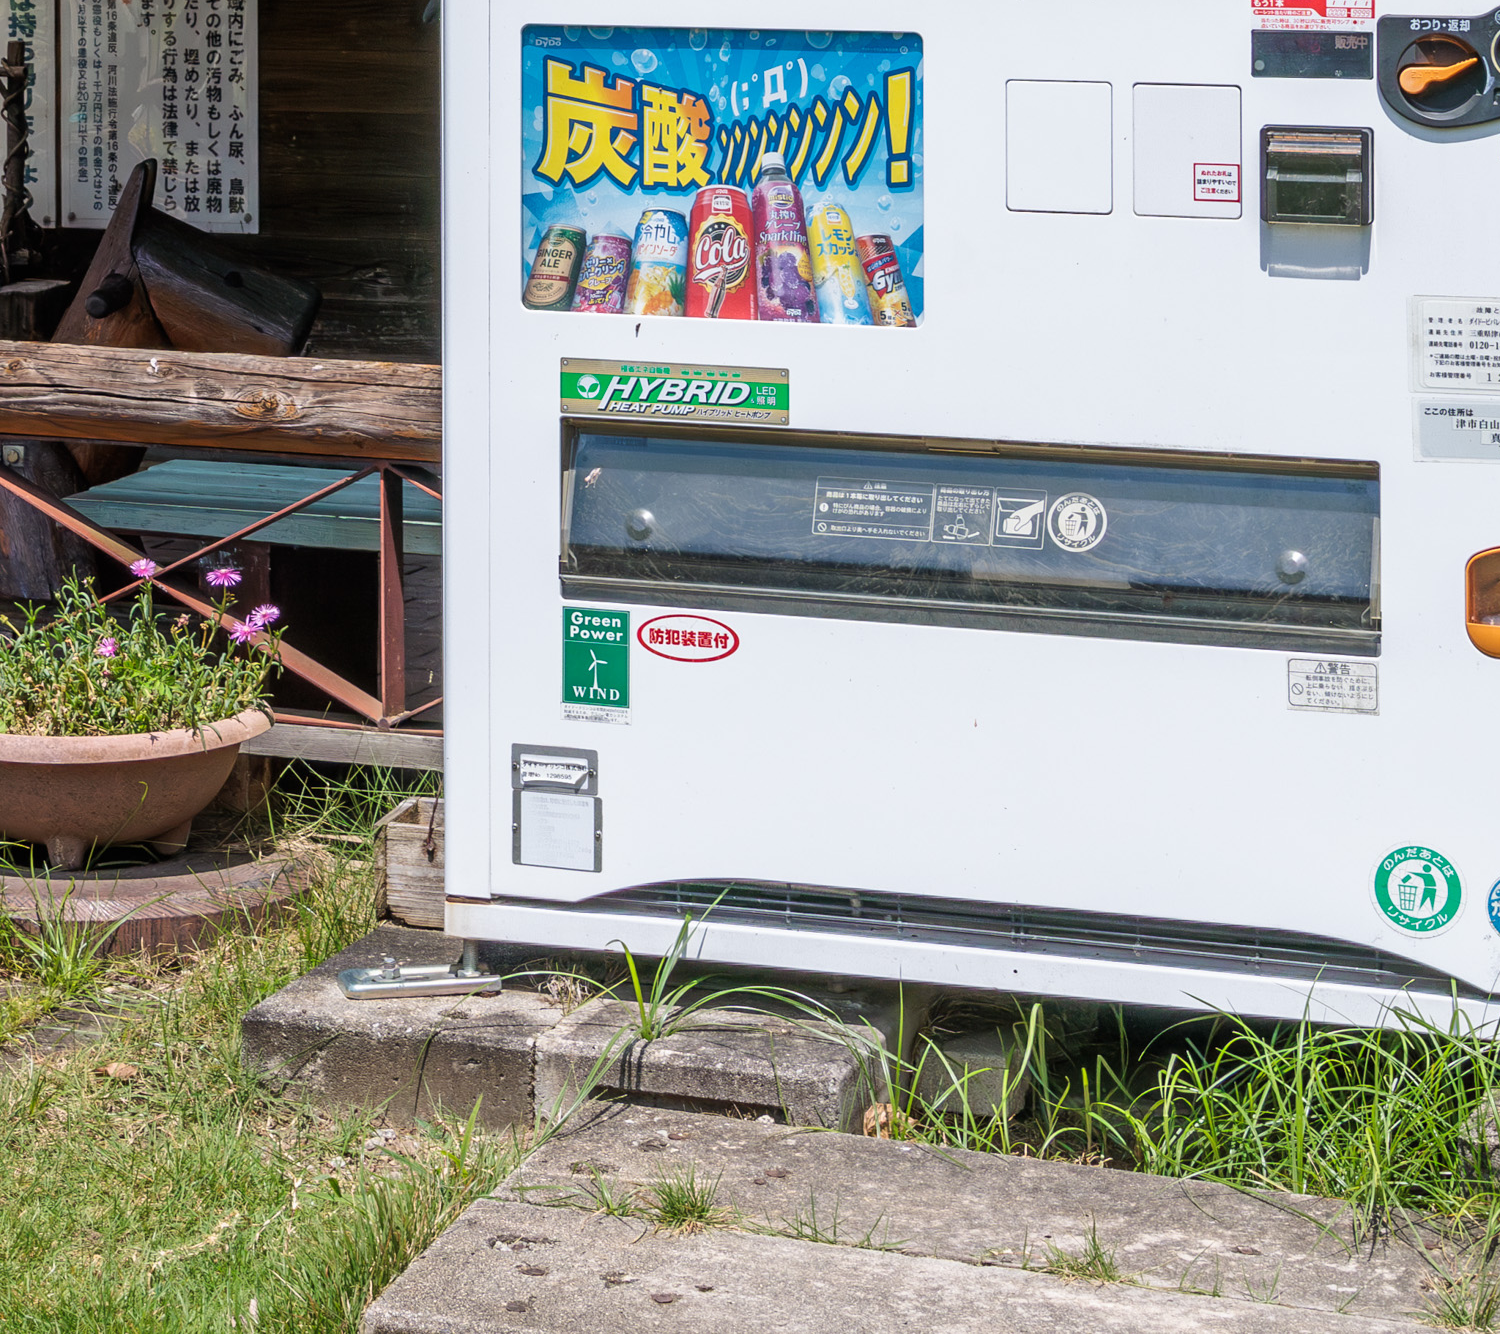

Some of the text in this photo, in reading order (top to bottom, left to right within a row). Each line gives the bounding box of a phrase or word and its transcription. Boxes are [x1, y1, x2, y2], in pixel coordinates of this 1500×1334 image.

[1253, 0, 1285, 7] もう1本
[535, 36, 562, 47] DyDo
[1334, 35, 1368, 50] 販売中
[639, 224, 678, 245] 冷やし
[822, 229, 853, 241] レモン
[537, 249, 573, 260] GINGER
[695, 225, 747, 270] Cola
[540, 259, 560, 269] ALE
[597, 375, 752, 411] HYBRID
[756, 386, 776, 396] LED
[609, 401, 650, 413] HEAT
[650, 404, 696, 415] PUMP
[696, 408, 732, 417] ハイブリッド
[756, 396, 776, 407] 照明
[1424, 408, 1474, 417] ここの住所は
[1056, 495, 1100, 516] のんだあとは
[1056, 532, 1096, 548] リサイクル
[570, 612, 621, 627] Green
[570, 626, 623, 641] Power
[649, 628, 729, 649] 防犯装置付
[1327, 663, 1351, 675] 警告
[572, 686, 620, 701] WIND
[1383, 847, 1455, 878] のんだあとは
[1386, 905, 1448, 930] リサイクル
